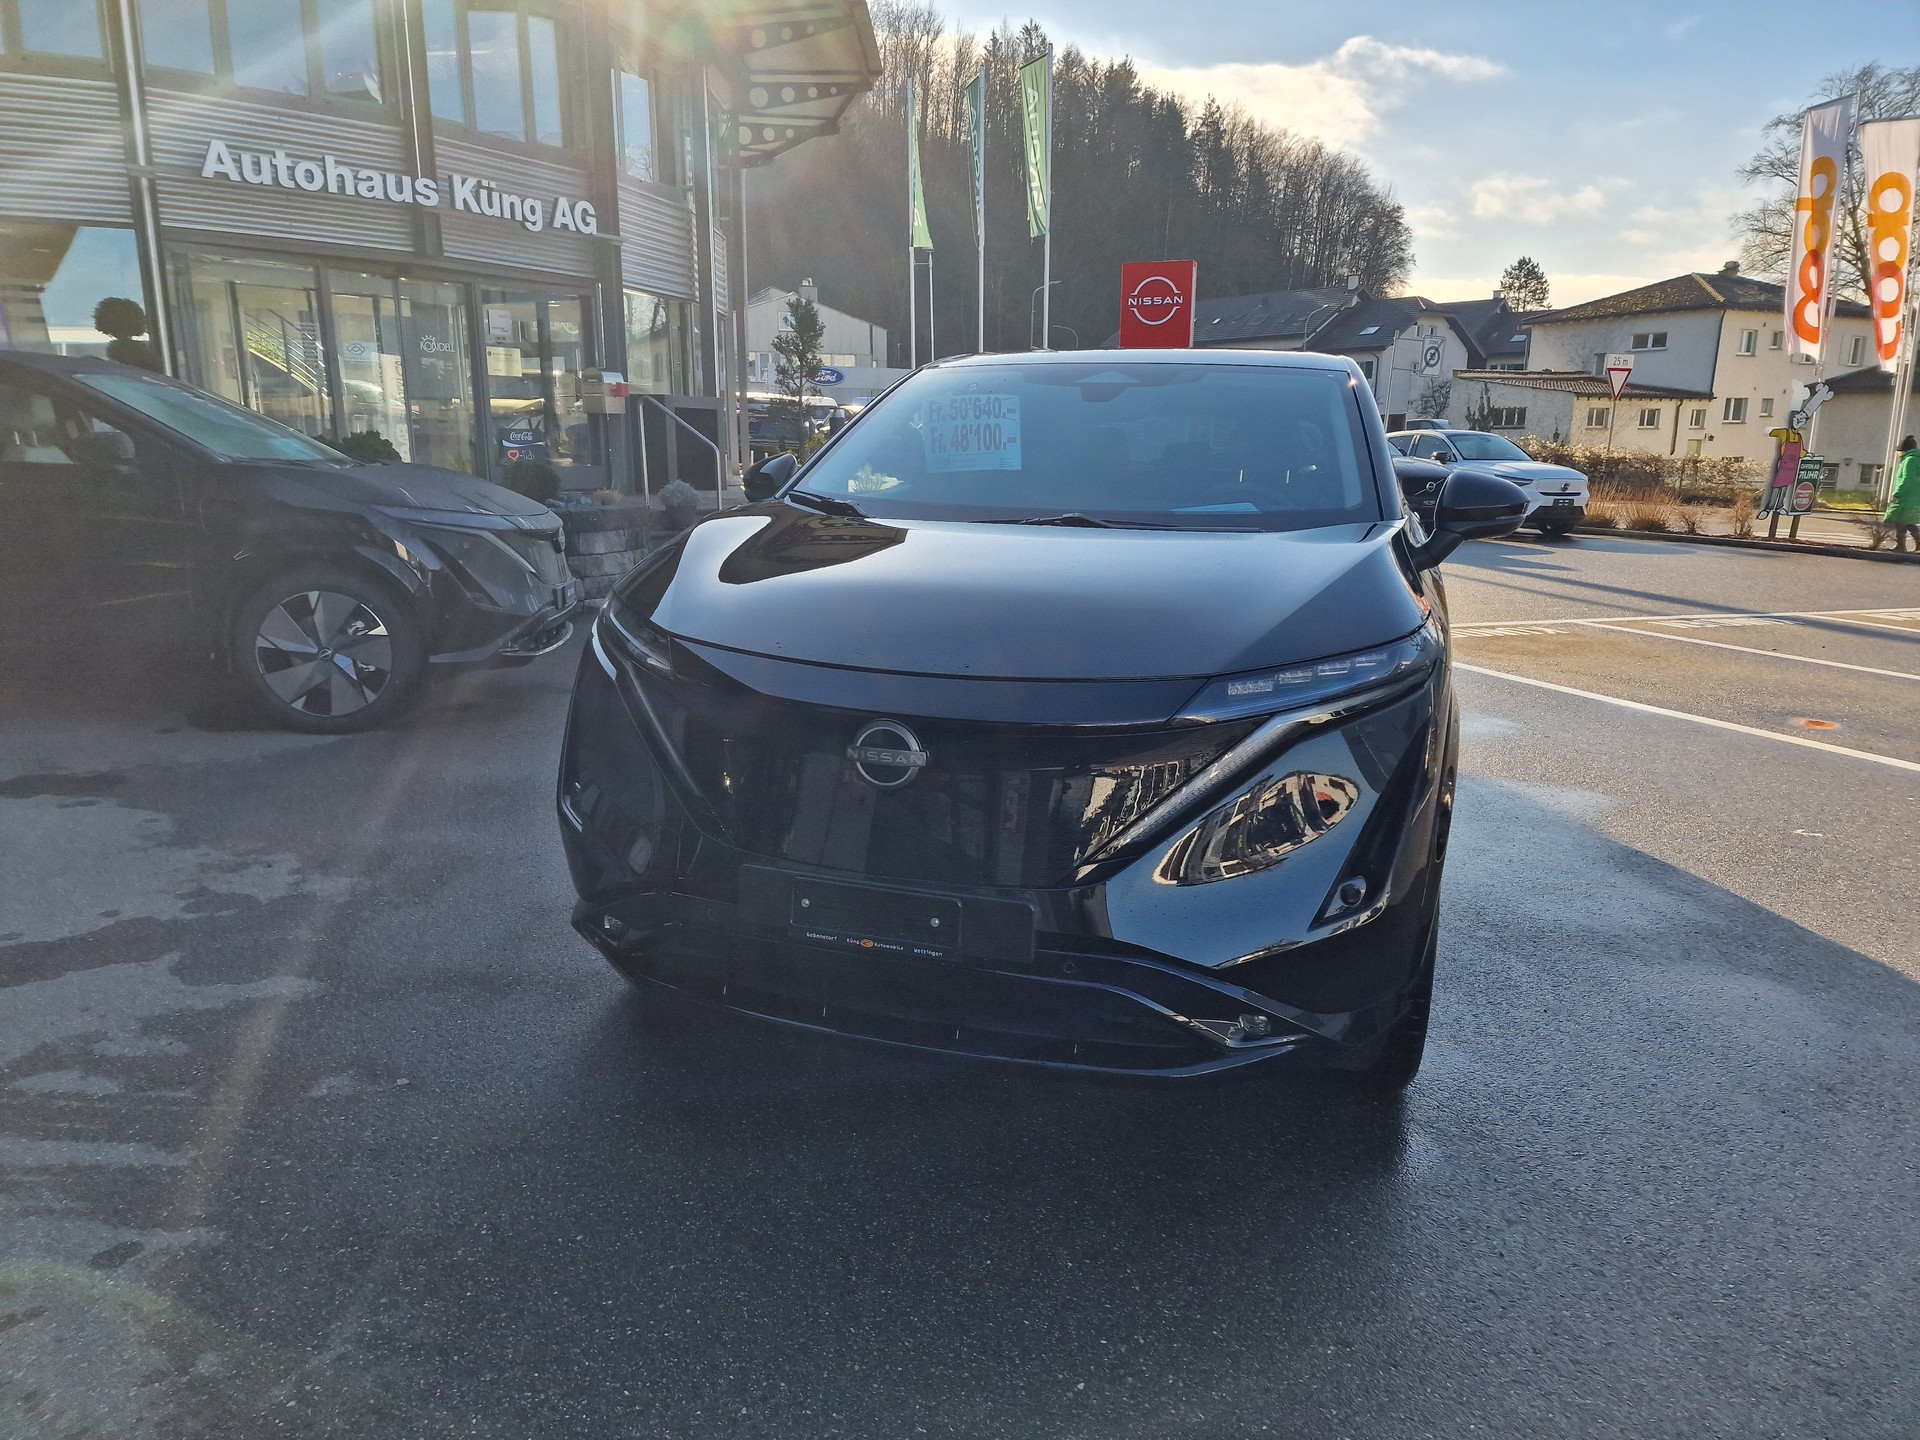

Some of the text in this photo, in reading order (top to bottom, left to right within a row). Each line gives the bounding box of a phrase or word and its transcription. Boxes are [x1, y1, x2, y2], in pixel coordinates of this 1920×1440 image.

[201, 139, 598, 235] Autohaus Küng AG
[1128, 295, 1183, 306] NISSAN
[1612, 356, 1621, 366] 25
[930, 426, 947, 453] Fr.
[1804, 470, 1819, 480] UHR
[846, 747, 926, 767] NISSAN
[806, 931, 838, 941] Gebenstorf
[913, 947, 943, 957] Wettingen
